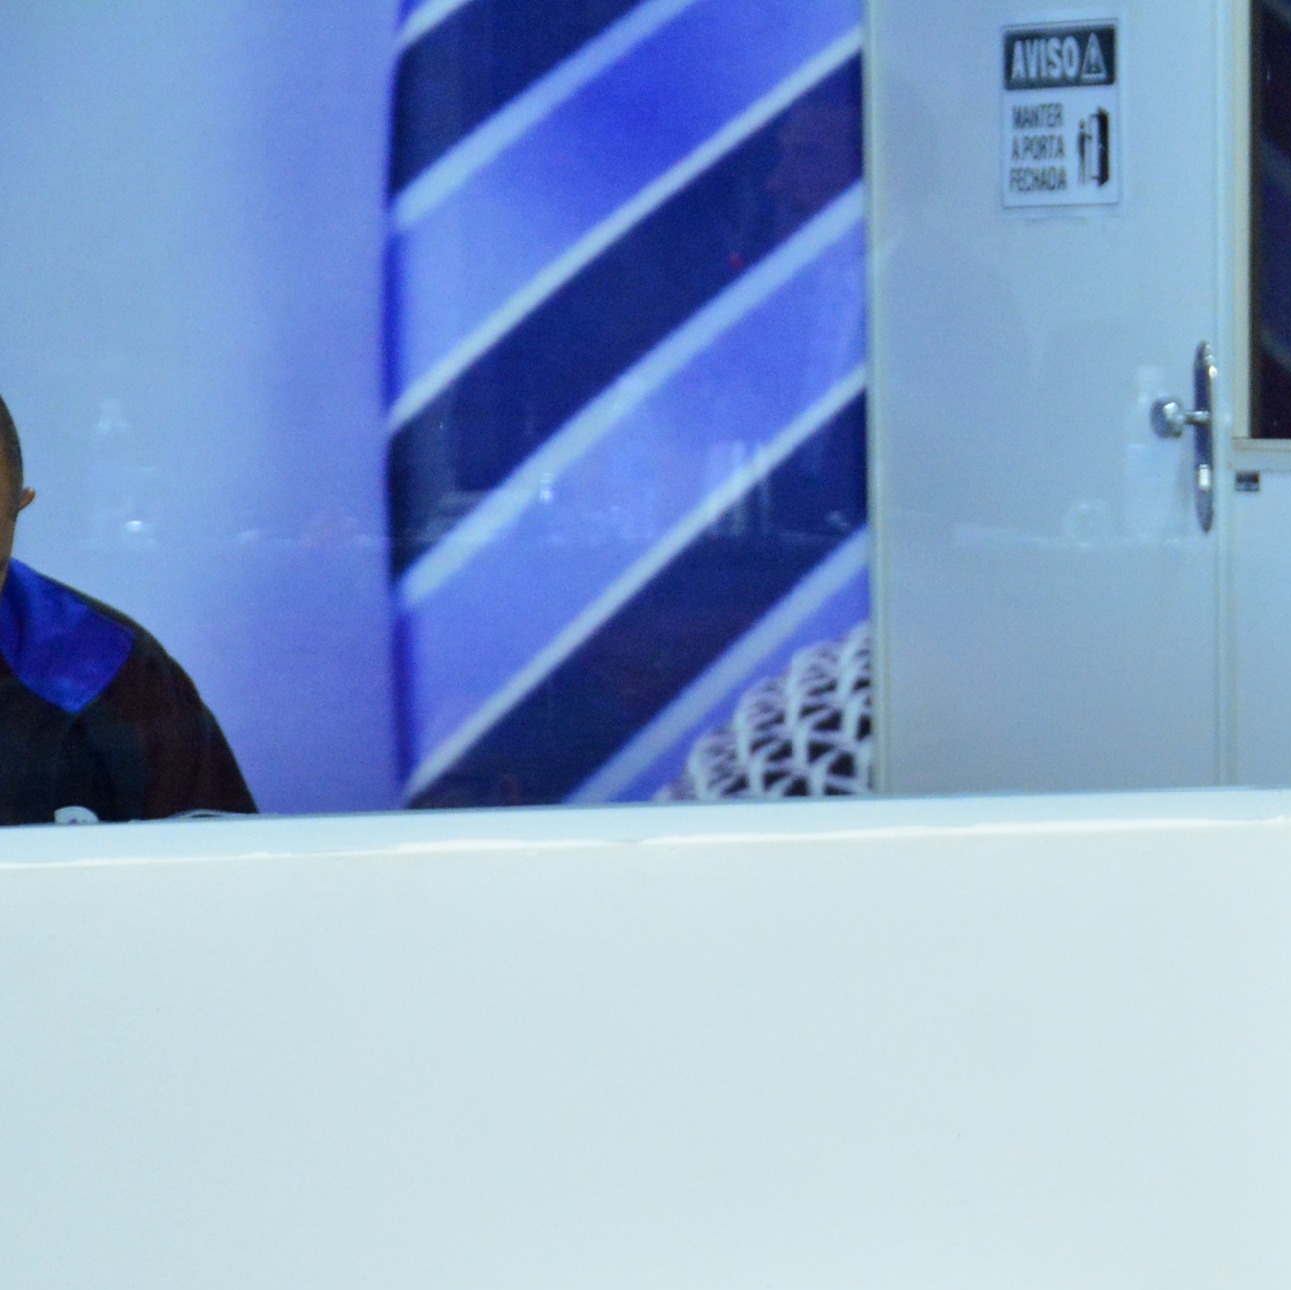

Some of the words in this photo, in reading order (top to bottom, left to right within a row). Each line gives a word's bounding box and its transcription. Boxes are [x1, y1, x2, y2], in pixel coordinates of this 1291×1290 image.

[1011, 36, 1080, 79] AVISO
[1012, 102, 1064, 129] MANTER
[1011, 135, 1020, 160] A
[1023, 134, 1065, 160] PORTA
[1009, 166, 1067, 191] FECHADA
